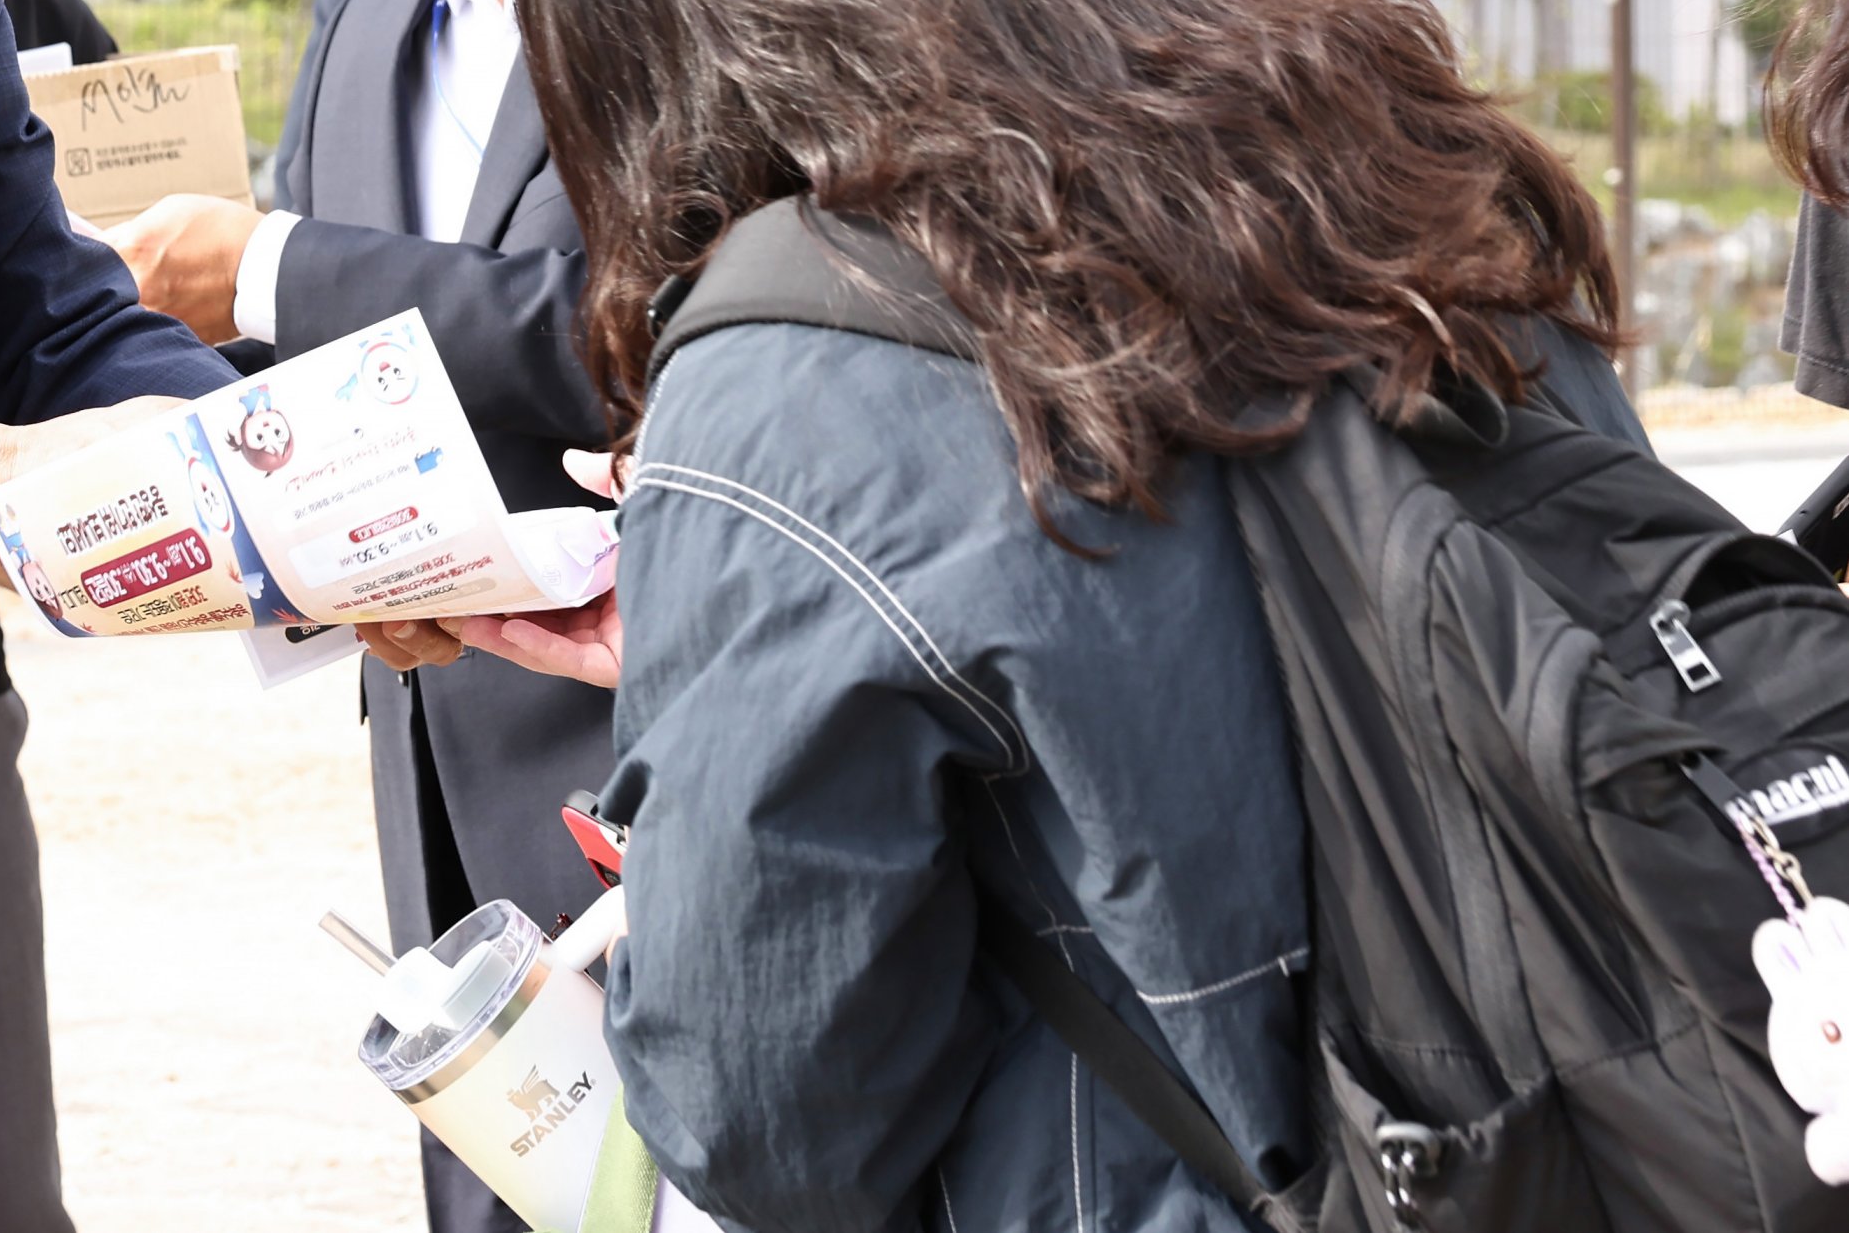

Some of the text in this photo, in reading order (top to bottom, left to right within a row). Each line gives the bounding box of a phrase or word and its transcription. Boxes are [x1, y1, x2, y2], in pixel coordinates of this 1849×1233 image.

[56, 485, 168, 554] 풍성한 한가위 보내세요!
[510, 1070, 593, 1158] STANLEY
